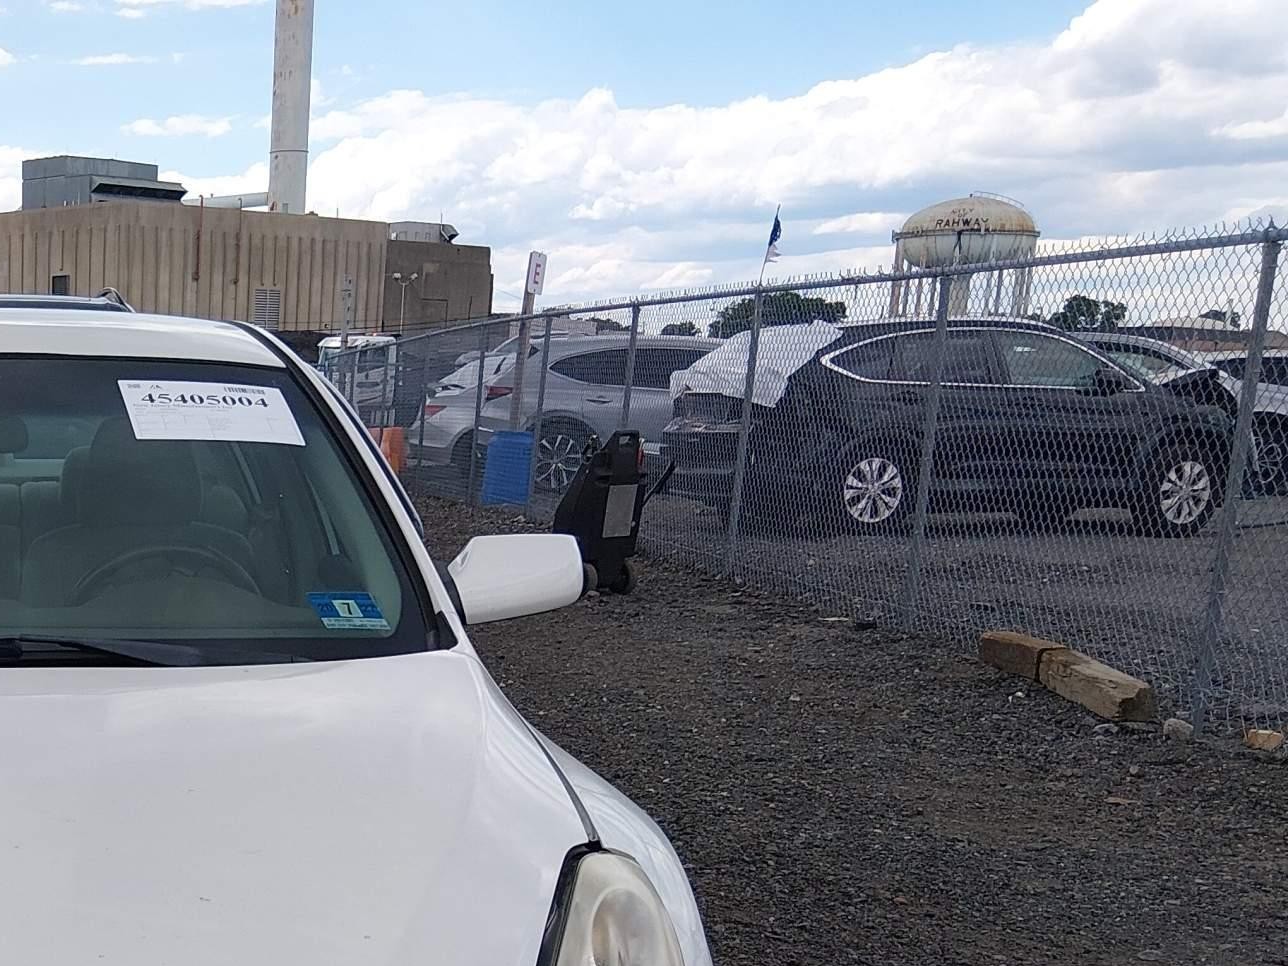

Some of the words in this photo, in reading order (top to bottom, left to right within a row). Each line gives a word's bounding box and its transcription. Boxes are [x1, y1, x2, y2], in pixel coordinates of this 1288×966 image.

[935, 217, 990, 229] RAHWAY
[533, 263, 542, 285] E
[141, 392, 269, 408] 45405004
[341, 602, 353, 615] 7
